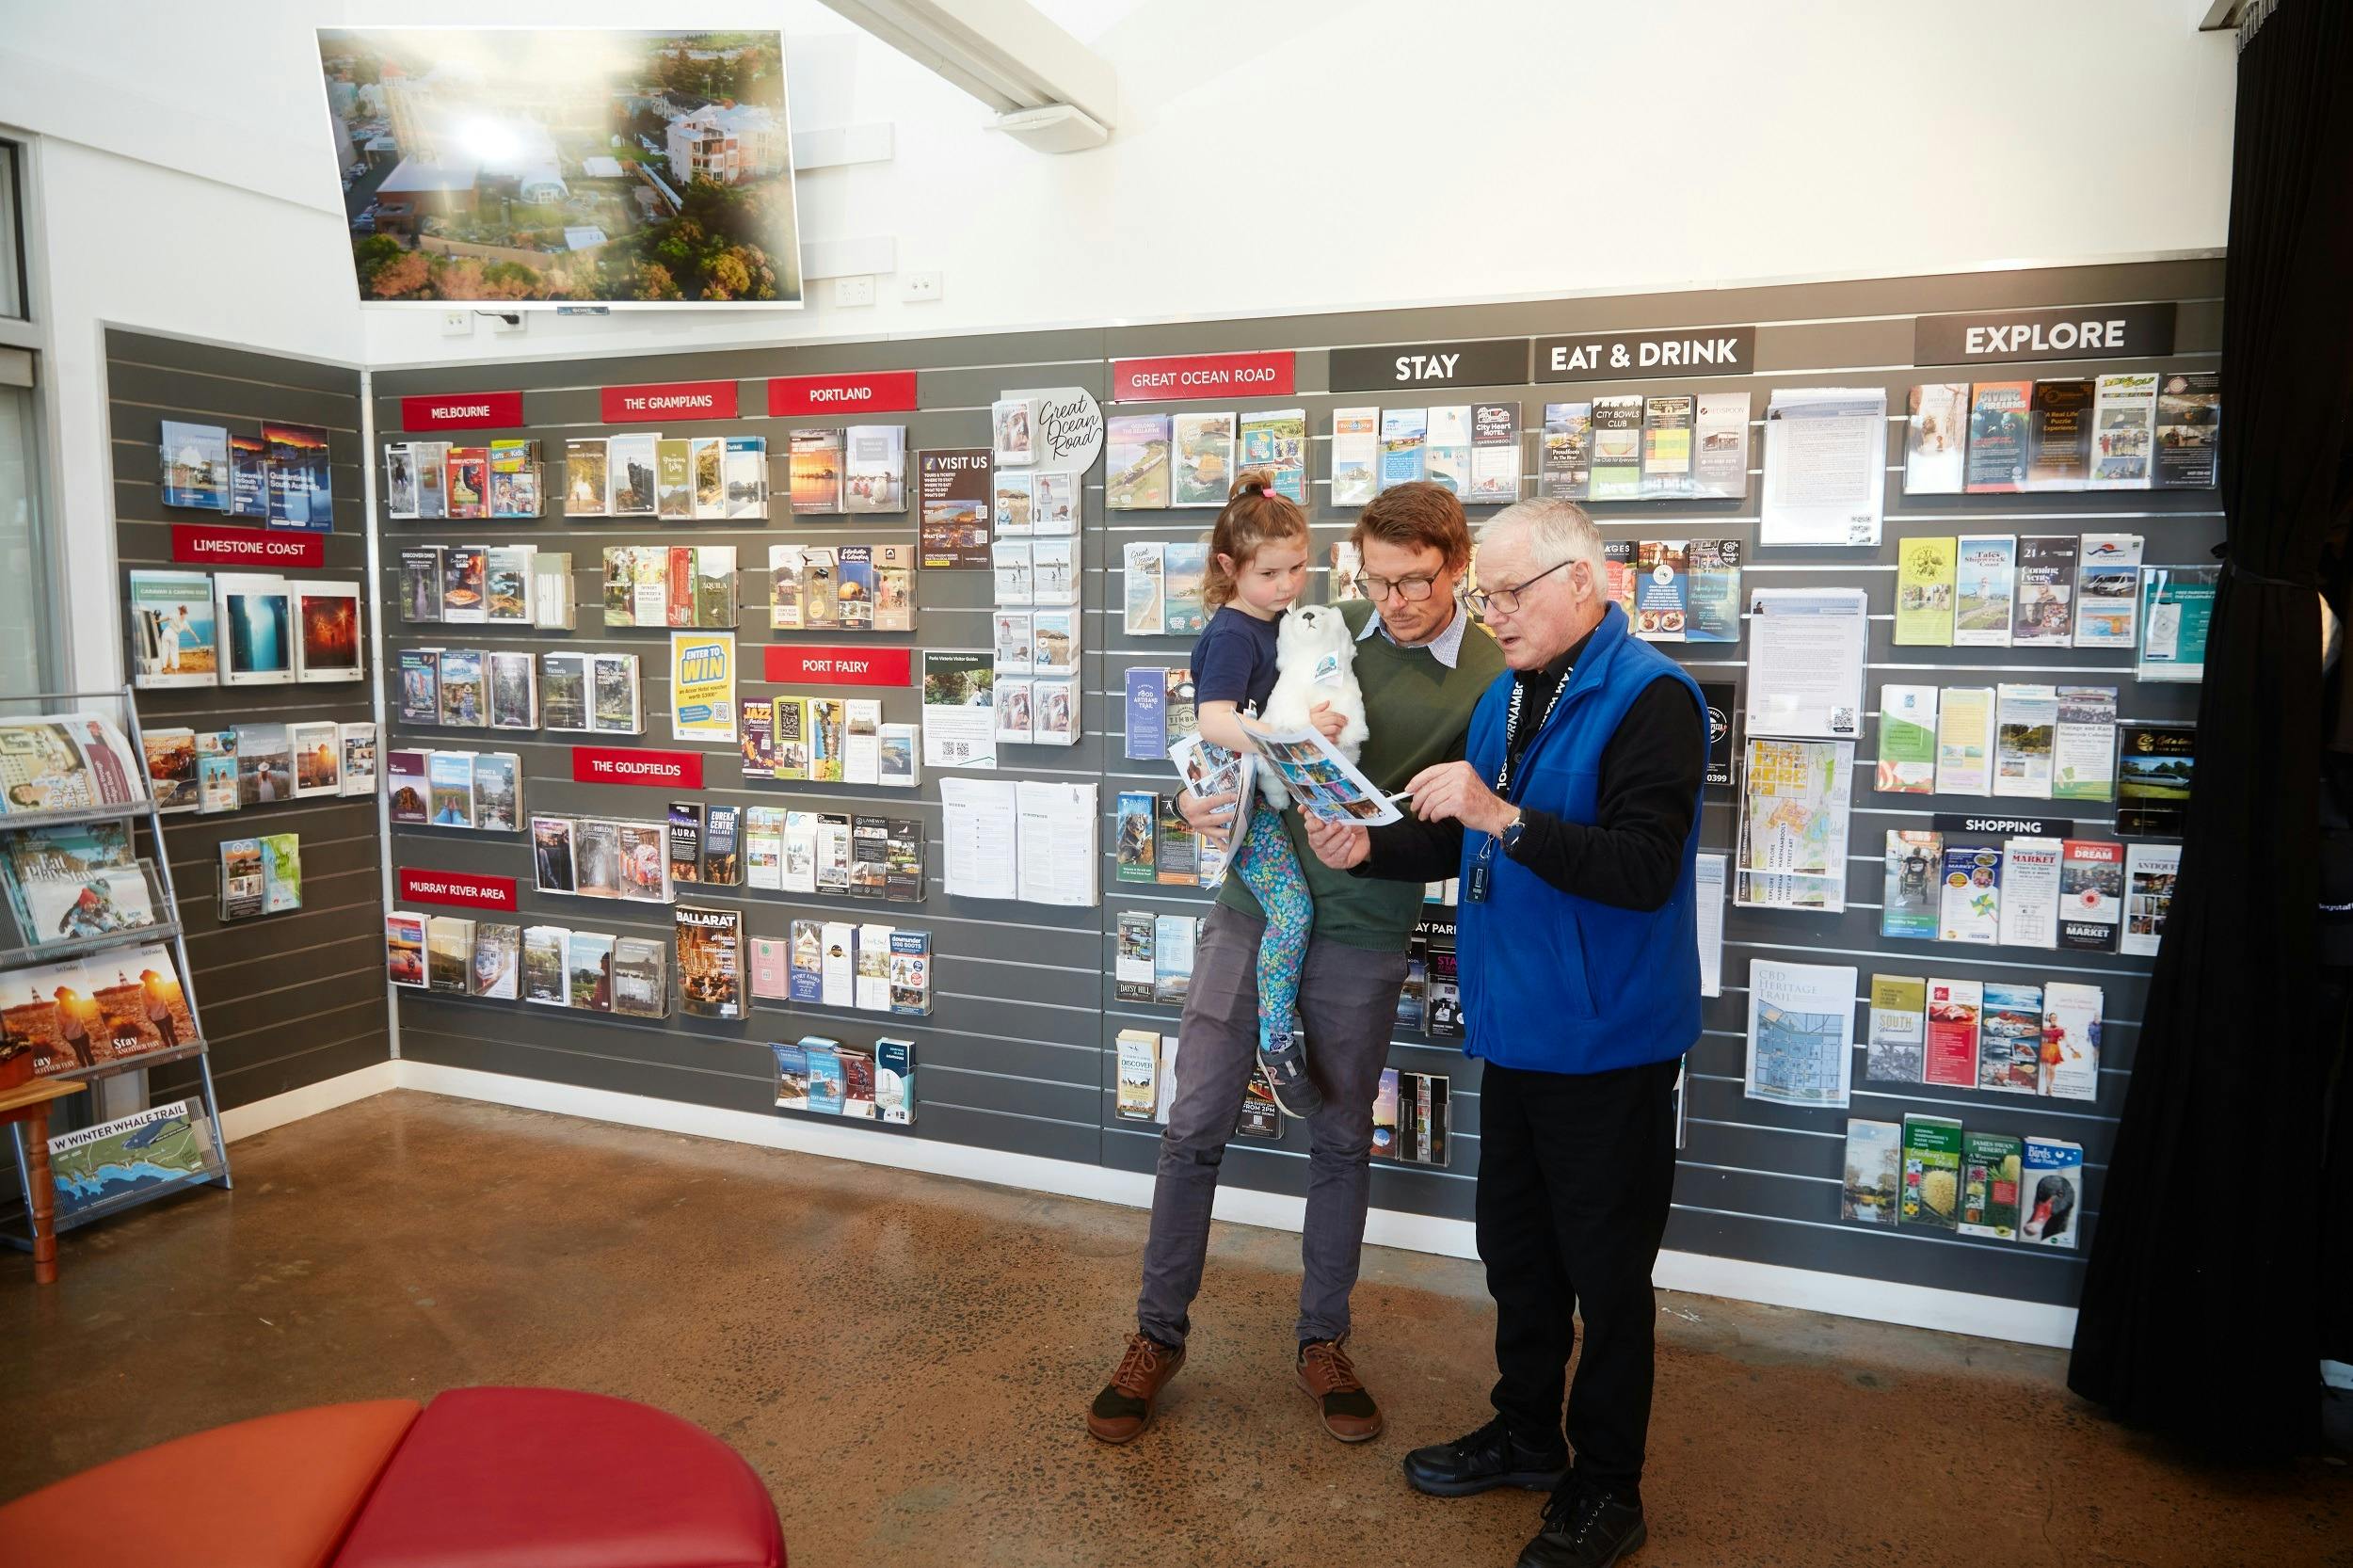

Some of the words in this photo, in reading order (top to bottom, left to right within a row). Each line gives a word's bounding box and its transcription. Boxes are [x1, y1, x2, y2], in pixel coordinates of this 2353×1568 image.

[1965, 320, 2126, 354] EXPLORE
[1551, 344, 1602, 371] EAT
[1609, 344, 1631, 368] &
[1639, 338, 1737, 367] DRINK
[1396, 354, 1460, 381] STAY
[1131, 373, 1176, 388] GREAT
[1180, 370, 1229, 385] OCEAN
[1235, 368, 1275, 383] ROAD
[625, 398, 646, 409] THE
[648, 394, 712, 408] GRAMPIANS
[809, 388, 872, 402] PORTLAND
[431, 406, 490, 419] MELBOURNE
[1039, 394, 1088, 425] Great
[1596, 410, 1613, 419] CITY
[1614, 410, 1640, 419] BOWLS
[1047, 415, 1099, 445] Ocean
[1476, 424, 1491, 432] City
[1053, 428, 1102, 461] Road
[937, 456, 968, 470] VISIT
[971, 456, 987, 469] US
[270, 472, 306, 483] Quarantine
[270, 480, 291, 488] South
[292, 483, 321, 491] Australia
[194, 539, 263, 553] LIMESTONE
[266, 543, 305, 555] COAST
[1605, 544, 1630, 552] AGES
[2023, 566, 2059, 575] Coming
[2022, 574, 2050, 583] Events
[686, 648, 710, 660] ENTER
[711, 646, 720, 657] TO
[682, 656, 724, 683] WIN
[802, 660, 832, 672] PORT
[836, 661, 870, 673] FAIRY
[744, 708, 772, 719] JAZZ
[1506, 680, 1524, 747] ARRNAMBO
[592, 760, 613, 772] THE
[616, 761, 680, 776] GOLDFIELDS
[711, 811, 735, 822] EUREKA
[710, 821, 734, 830] CENTRE
[1965, 819, 2041, 833] SHOPPING
[671, 827, 696, 838] AURA
[2012, 855, 2056, 864] MARKET
[2074, 850, 2112, 860] DREAM
[39, 854, 67, 870] Eat
[2137, 862, 2176, 871] ANTIQUE
[24, 865, 60, 885] Play
[62, 870, 94, 883] Stay
[409, 881, 447, 893] MURRAY
[450, 885, 478, 897] RIVER
[480, 888, 505, 900] AREA
[676, 911, 736, 926] BALLARAT
[2066, 927, 2110, 937] MARKET
[1437, 956, 1457, 966] STA
[1758, 970, 1785, 981] CBD
[1120, 984, 1137, 994] DAYSY
[1138, 986, 1150, 995] HILL
[1759, 980, 1817, 995] HERITAGE
[1759, 989, 1791, 1001] TRAIL
[1880, 1016, 1913, 1029] SOUTH
[113, 1036, 137, 1049] Stay
[118, 1044, 145, 1055] ANOTHER
[145, 1040, 160, 1049] DAY
[1121, 1059, 1152, 1068] DISCOVER
[68, 1127, 113, 1145] WINTER
[113, 1115, 153, 1132] WHALE
[153, 1105, 184, 1121] TRAIL
[2027, 1145, 2051, 1159] Birds
